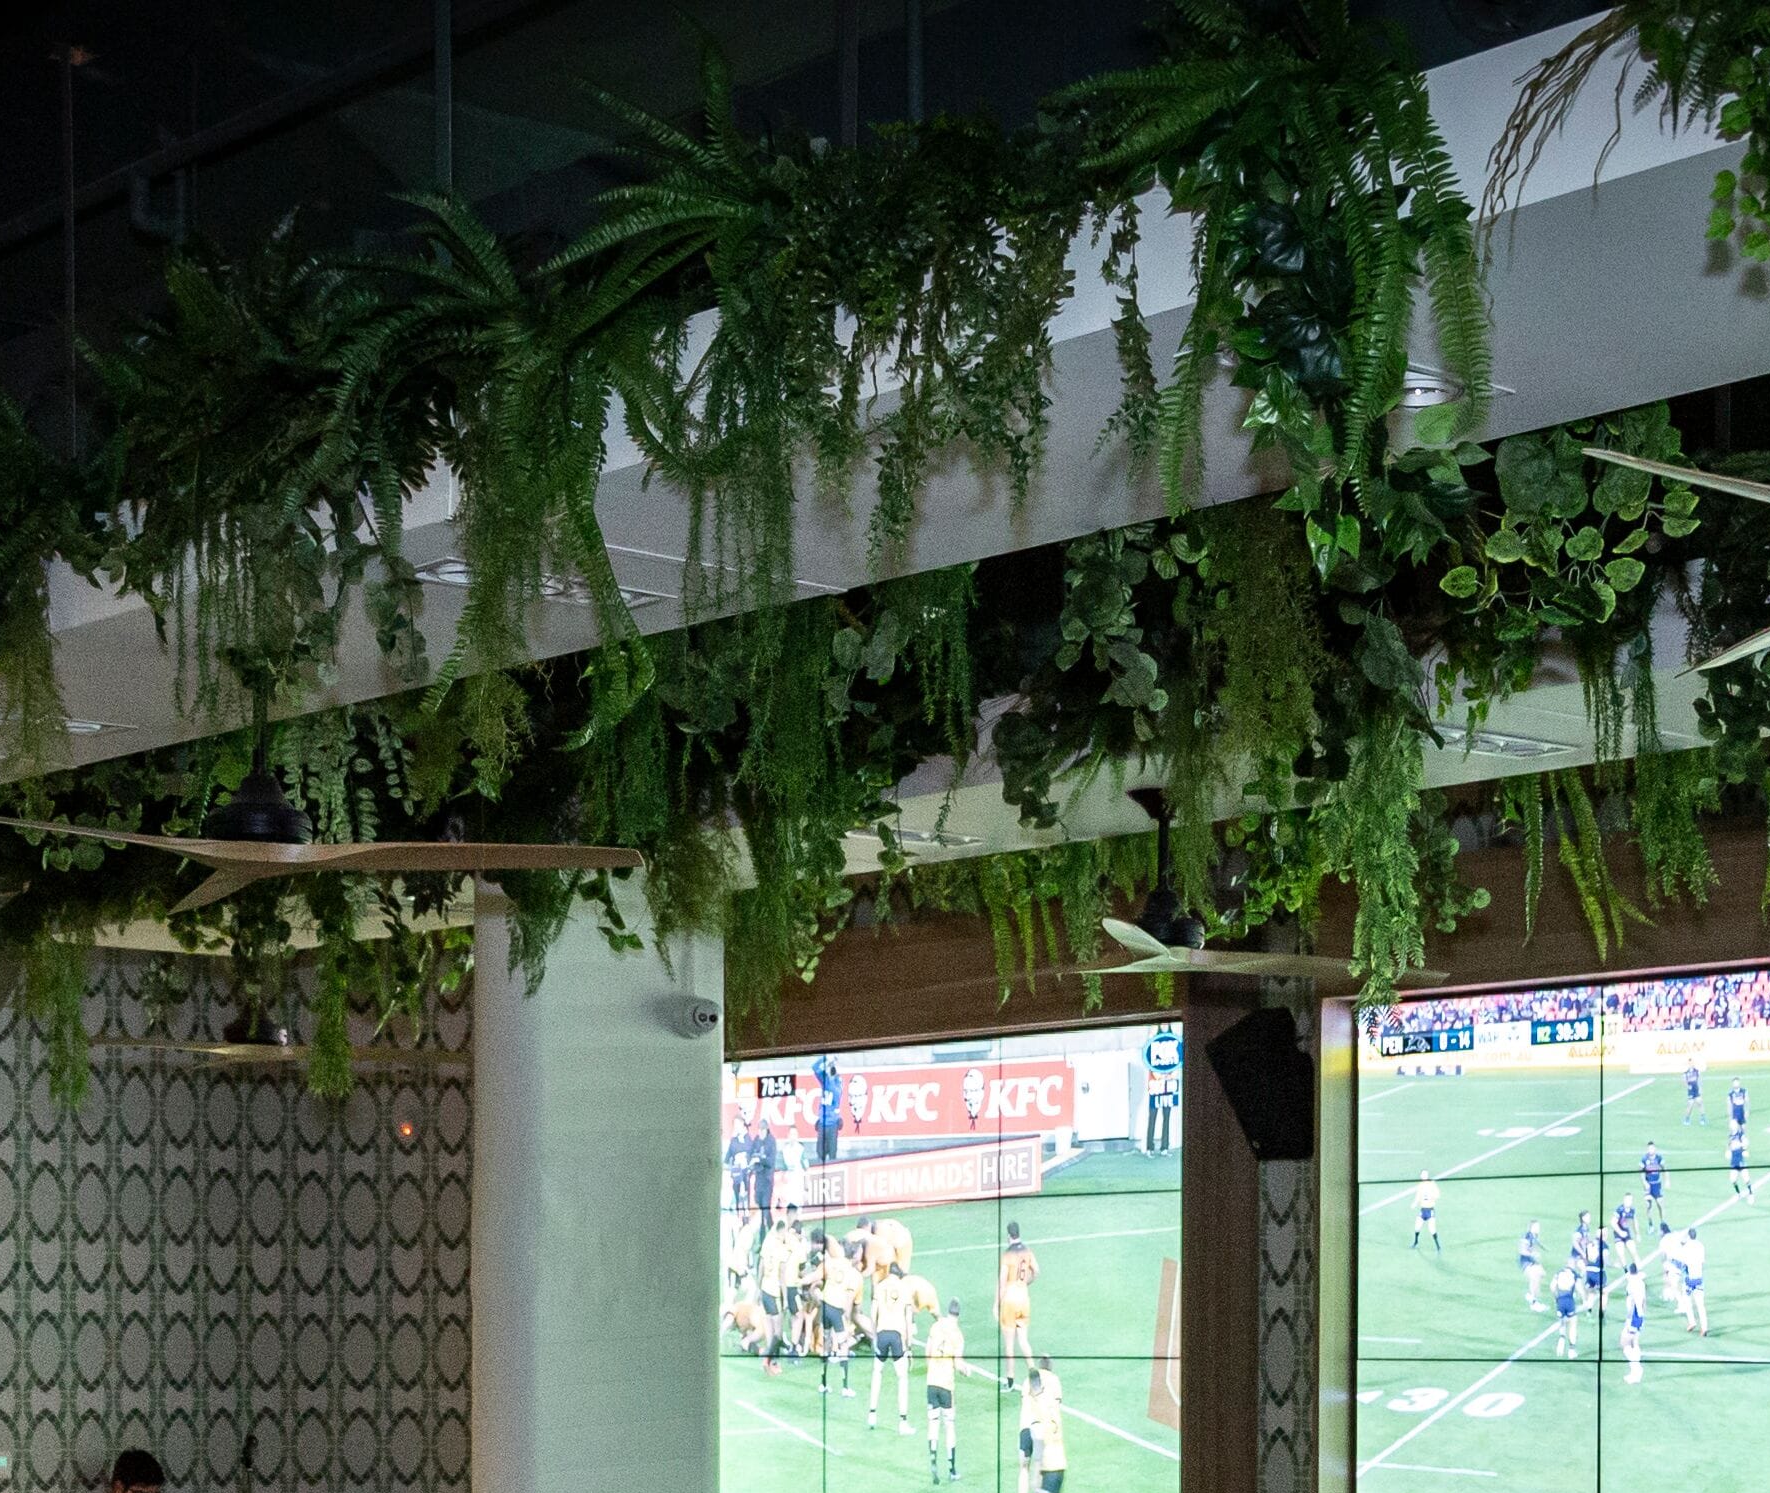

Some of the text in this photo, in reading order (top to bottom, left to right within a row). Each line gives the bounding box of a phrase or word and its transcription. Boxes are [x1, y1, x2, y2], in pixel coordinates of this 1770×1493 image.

[868, 1082, 941, 1123] KFC
[985, 1074, 1064, 1119] KFC
[863, 1151, 1029, 1199] KENNARDS HIRE
